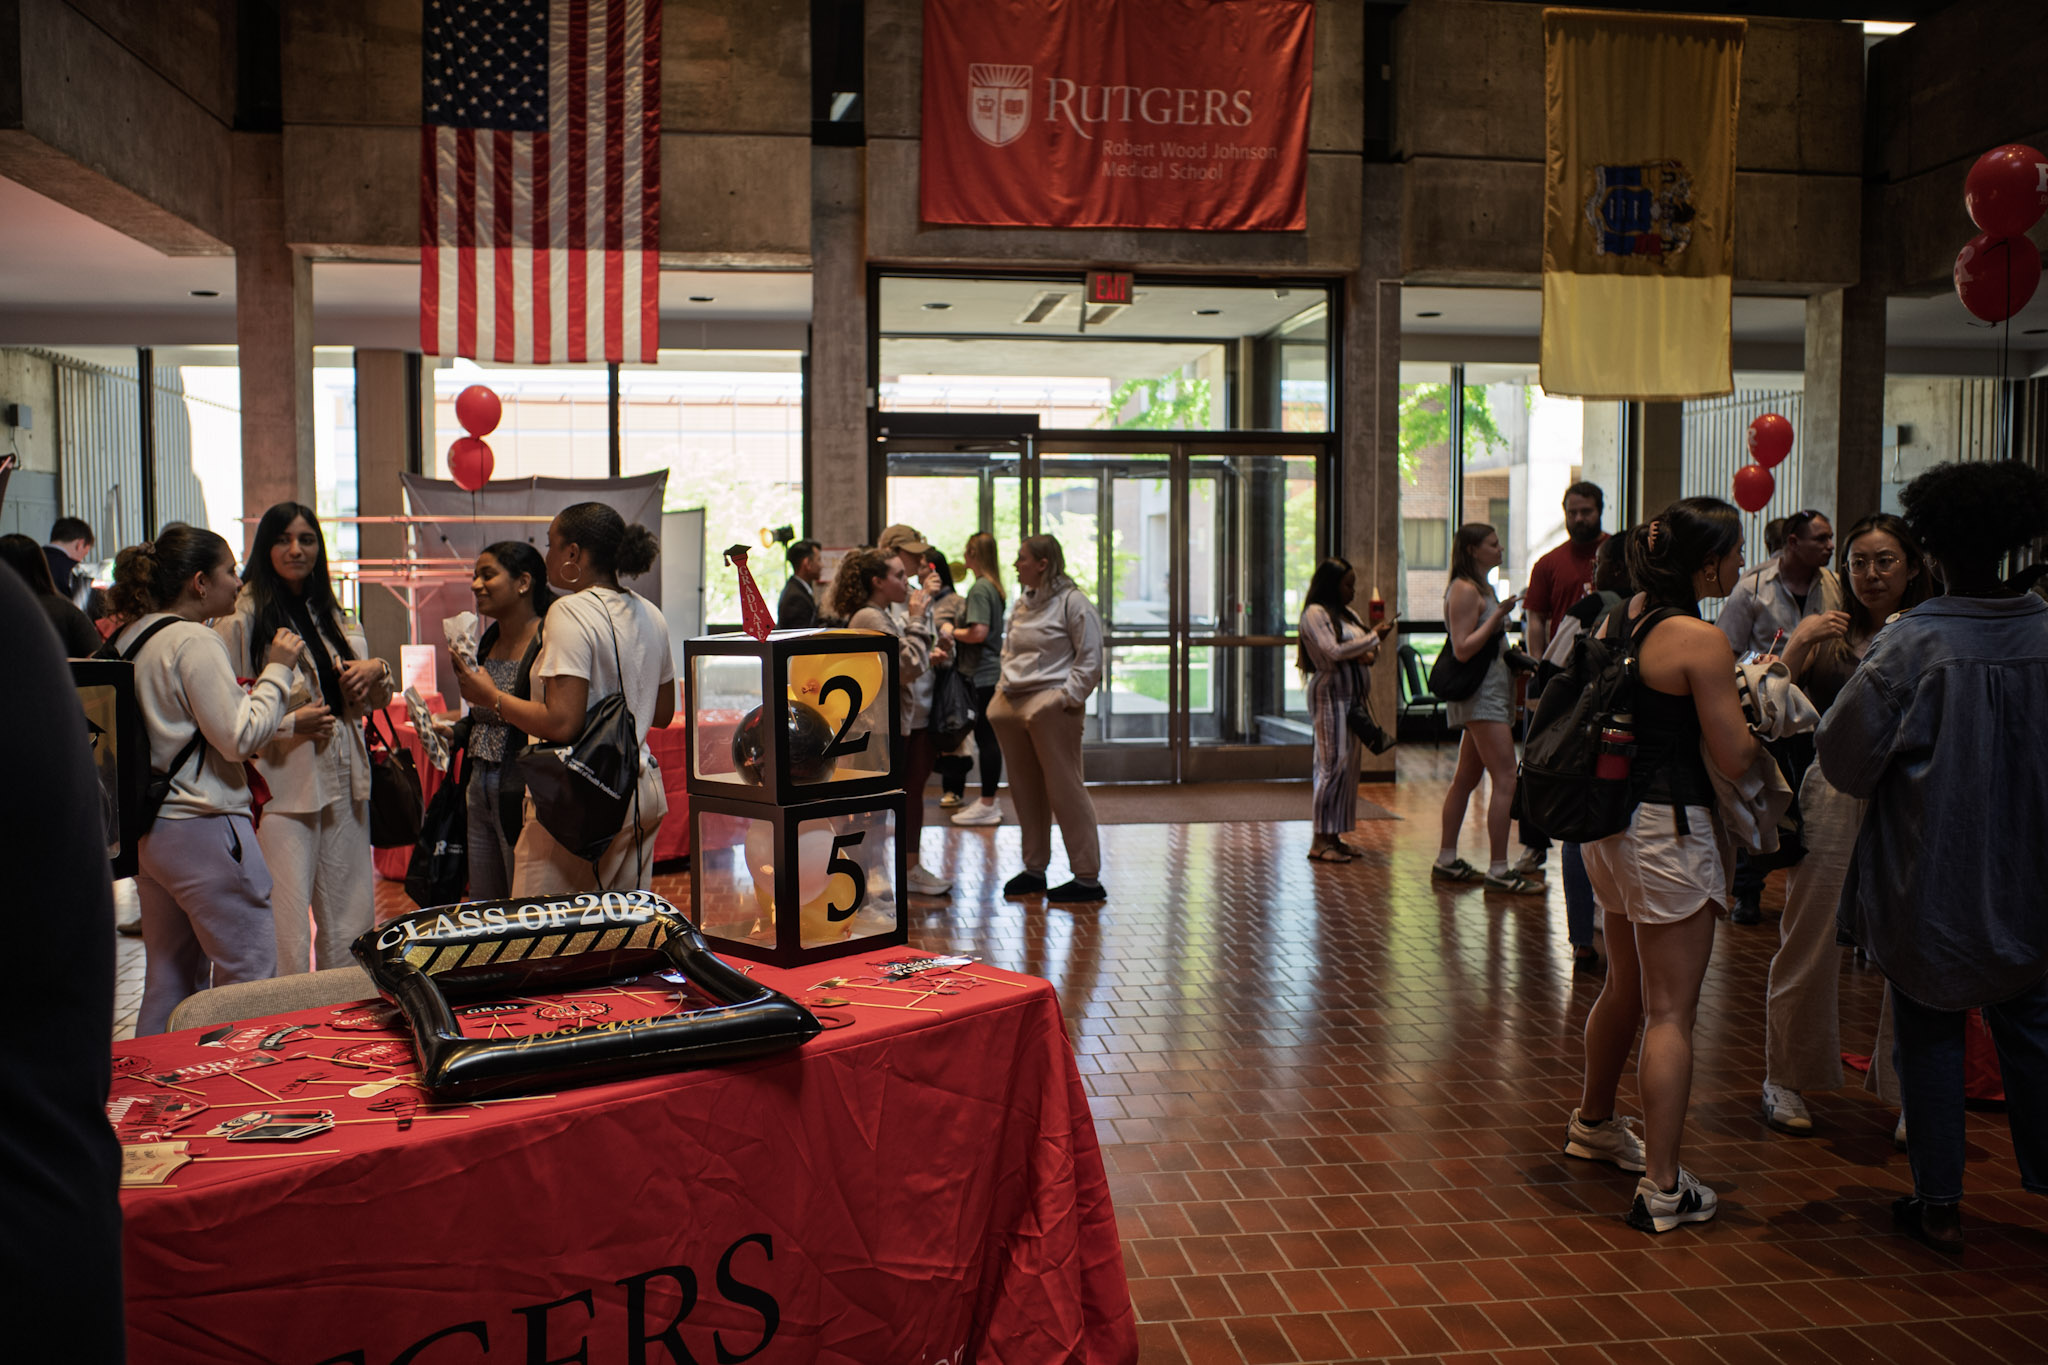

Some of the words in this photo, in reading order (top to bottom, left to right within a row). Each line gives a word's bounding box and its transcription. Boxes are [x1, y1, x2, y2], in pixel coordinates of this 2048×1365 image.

[1044, 77, 1253, 140] RUTGERS
[1101, 160, 1164, 179] Medical
[1170, 162, 1223, 180] School
[1102, 140, 1155, 158] Robert
[1160, 141, 1207, 159] Wood
[1211, 142, 1278, 160] Johnson
[1096, 275, 1129, 301] EXIT
[738, 565, 766, 641] GRADUATE
[817, 674, 872, 759] 2
[826, 830, 867, 922] 5
[376, 906, 508, 951] CLASS
[517, 900, 572, 932] OF
[574, 891, 680, 926] 2025
[466, 1004, 520, 1015] GRAD
